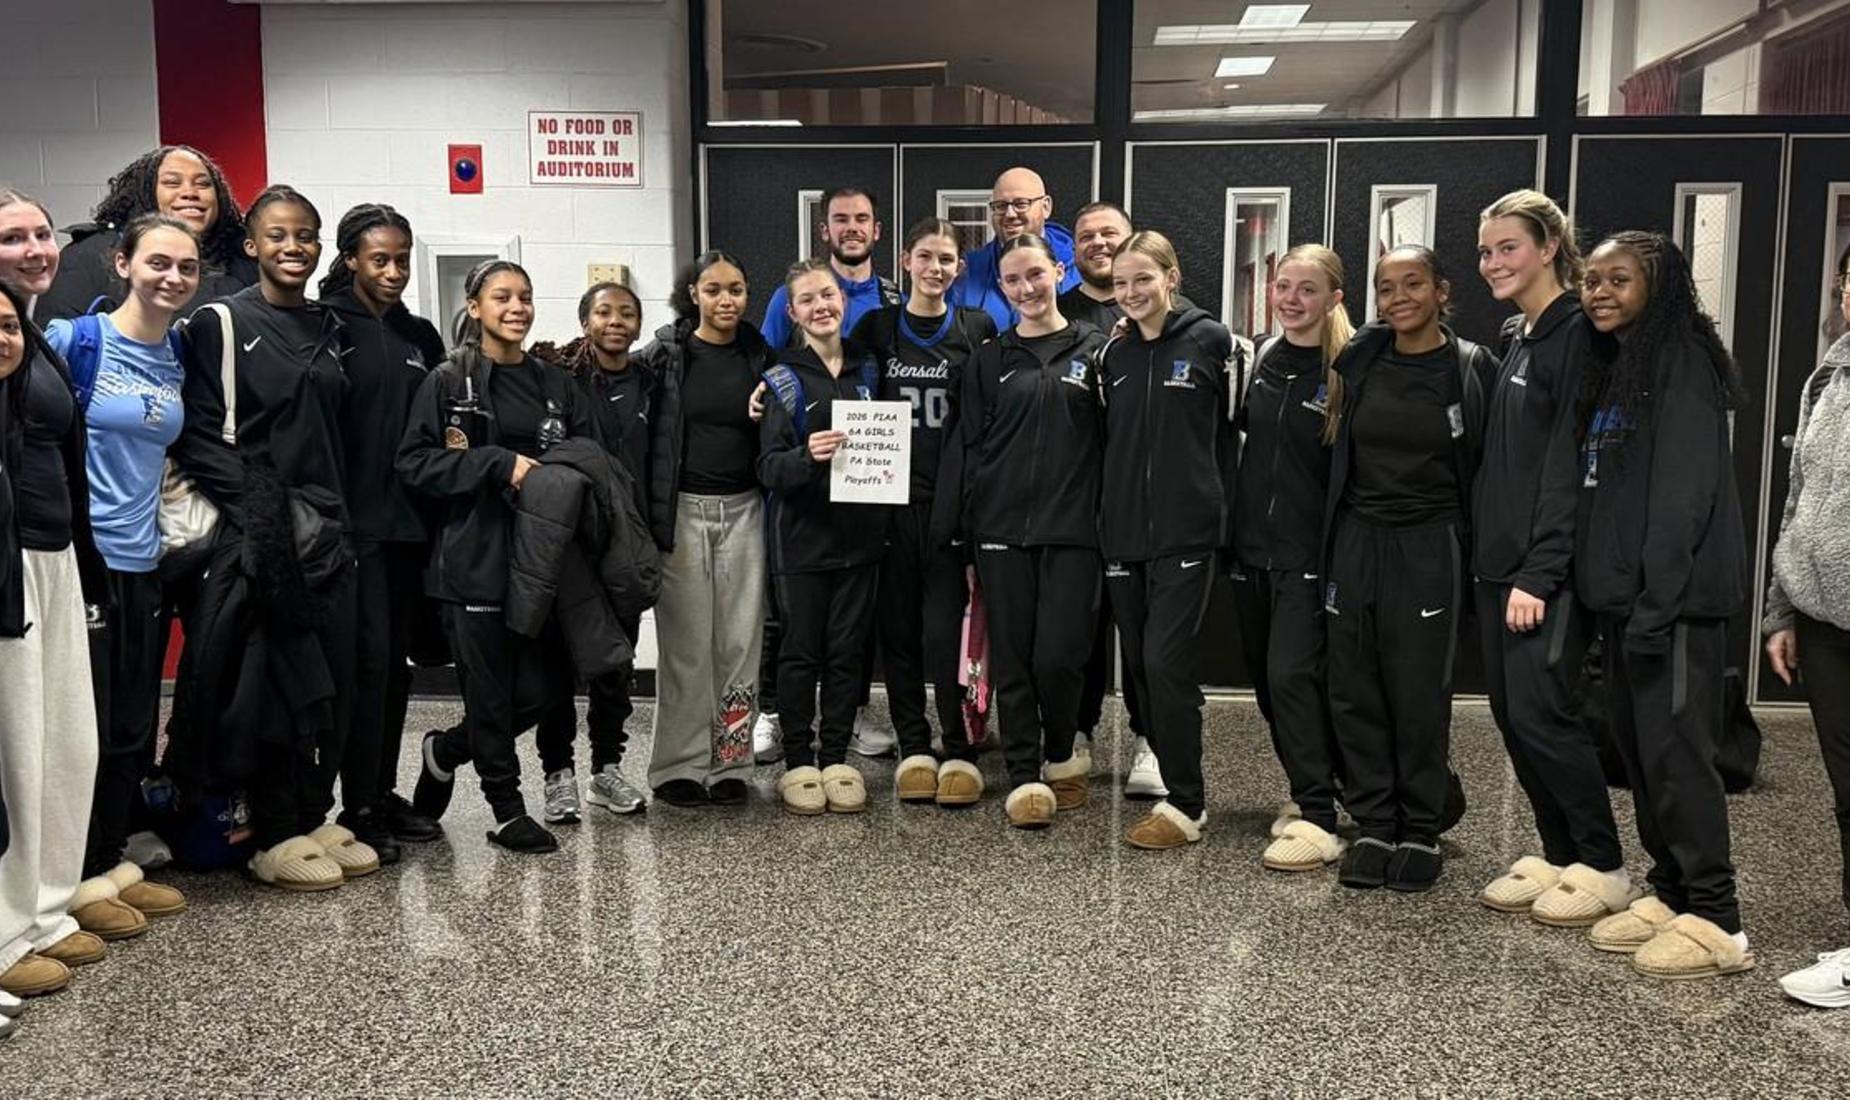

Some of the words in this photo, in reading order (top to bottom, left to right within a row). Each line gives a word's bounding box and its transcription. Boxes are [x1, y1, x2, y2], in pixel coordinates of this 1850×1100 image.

[537, 118, 558, 134] NO
[565, 119, 605, 135] FOOD
[612, 119, 633, 135] OR
[547, 140, 596, 156] DRINK
[603, 140, 619, 156] IN
[537, 161, 634, 178] AUDITORIUM
[873, 412, 897, 422] PIAA
[848, 428, 861, 436] 6A
[864, 427, 895, 436] GIRLS
[841, 441, 900, 452] BASKETBALL
[850, 456, 862, 465] PA
[865, 457, 892, 466] State
[844, 474, 881, 486] Playoffs
